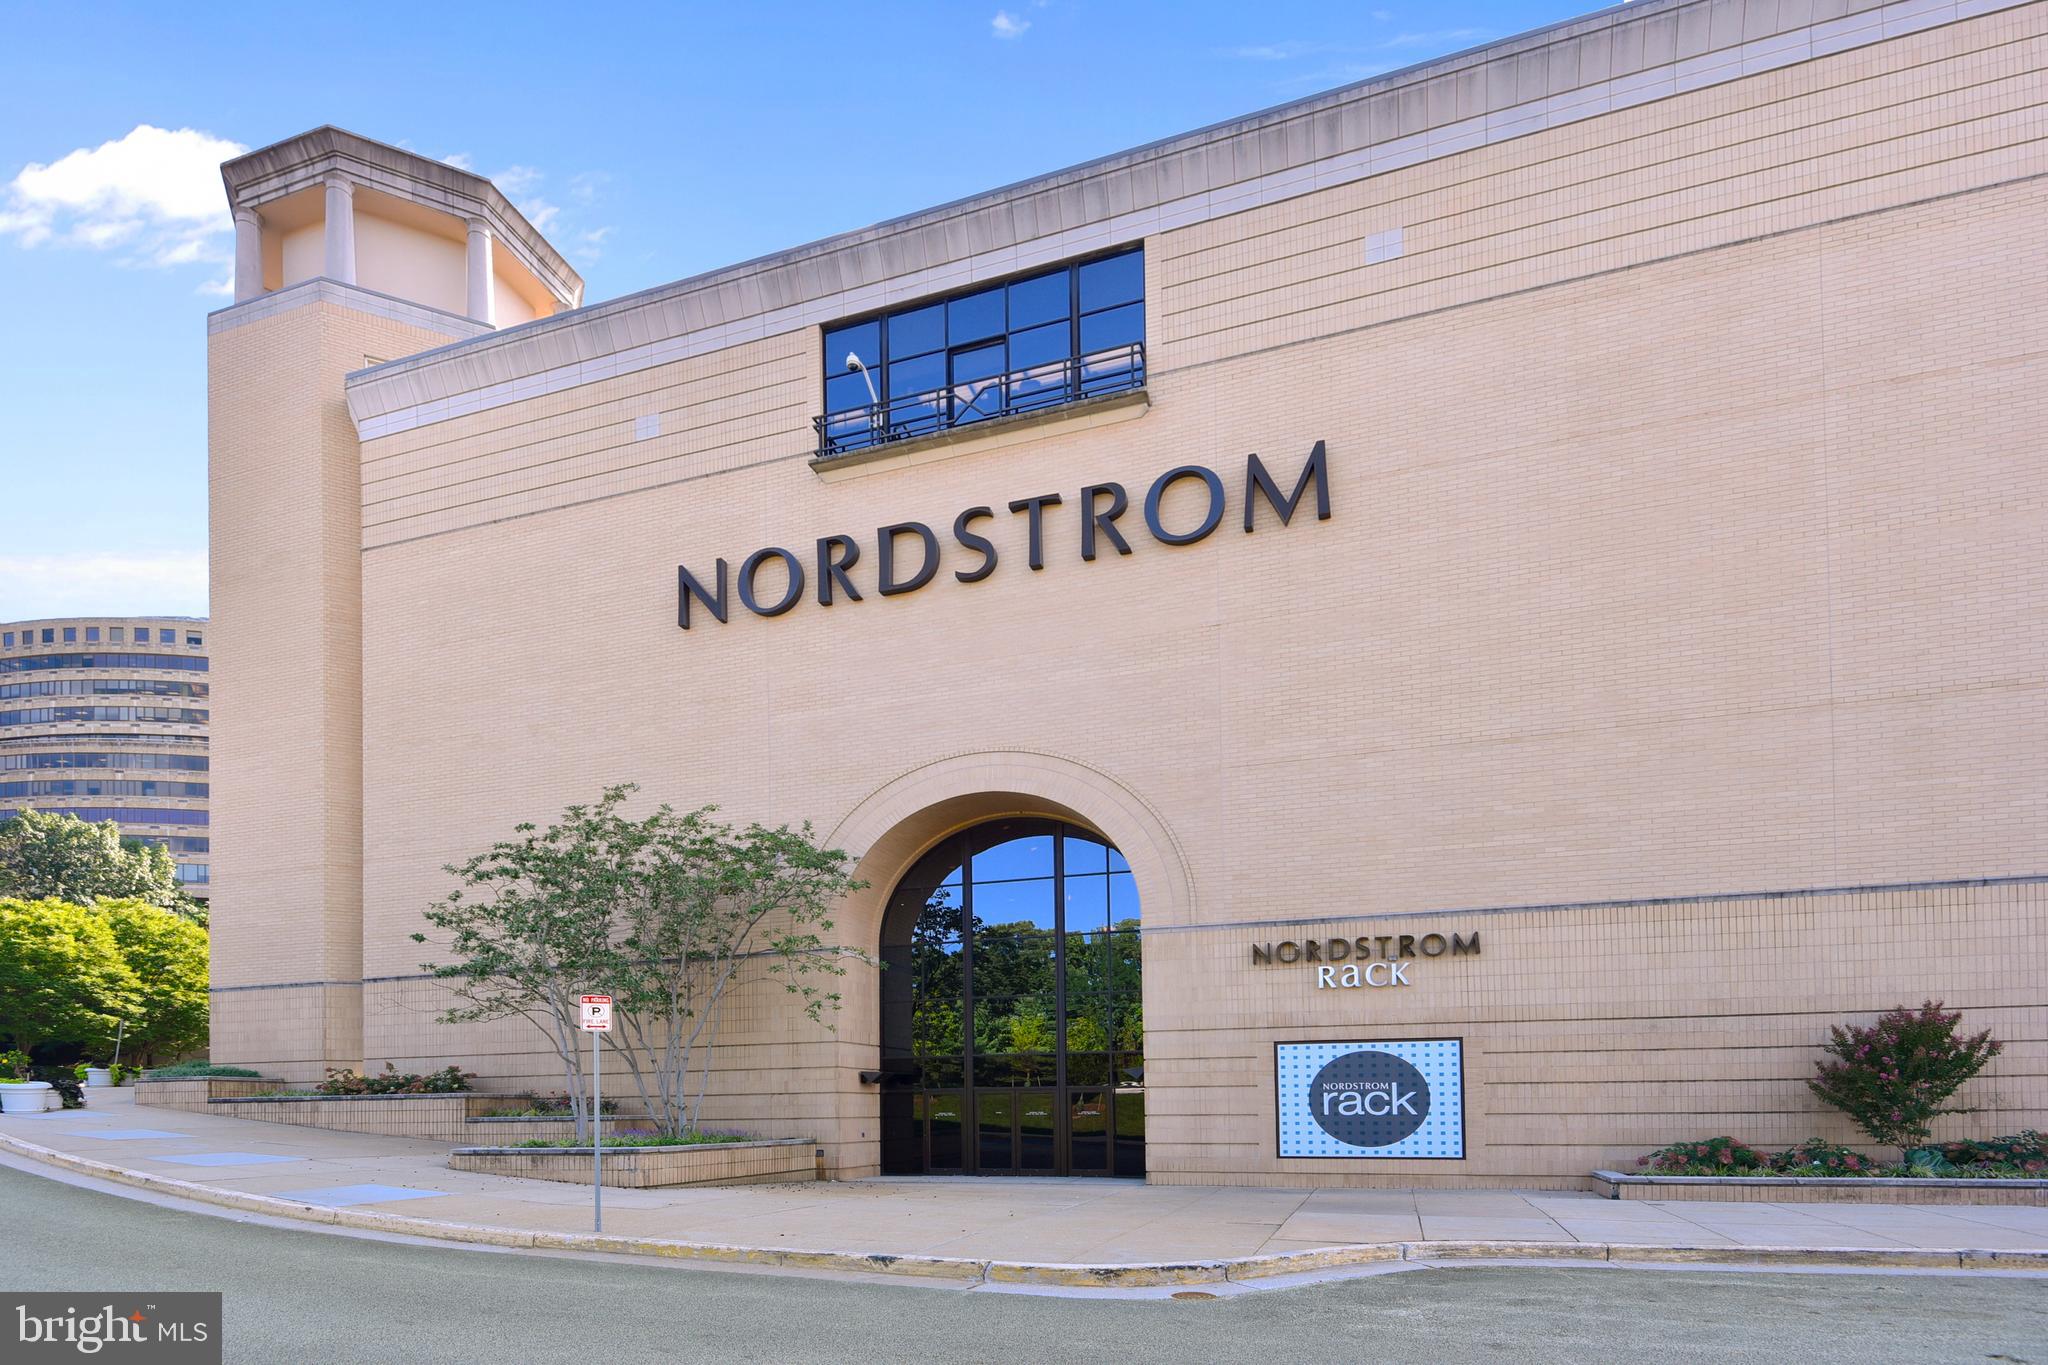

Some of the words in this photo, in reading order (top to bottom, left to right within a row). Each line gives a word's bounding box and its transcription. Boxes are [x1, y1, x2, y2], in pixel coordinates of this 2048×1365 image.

[677, 439, 1331, 630] NORDSTROM
[1252, 931, 1481, 965] NORDSTROM
[592, 1007, 601, 1016] P
[1322, 1082, 1389, 1090] NORDSTROM
[1323, 1082, 1418, 1116] rack
